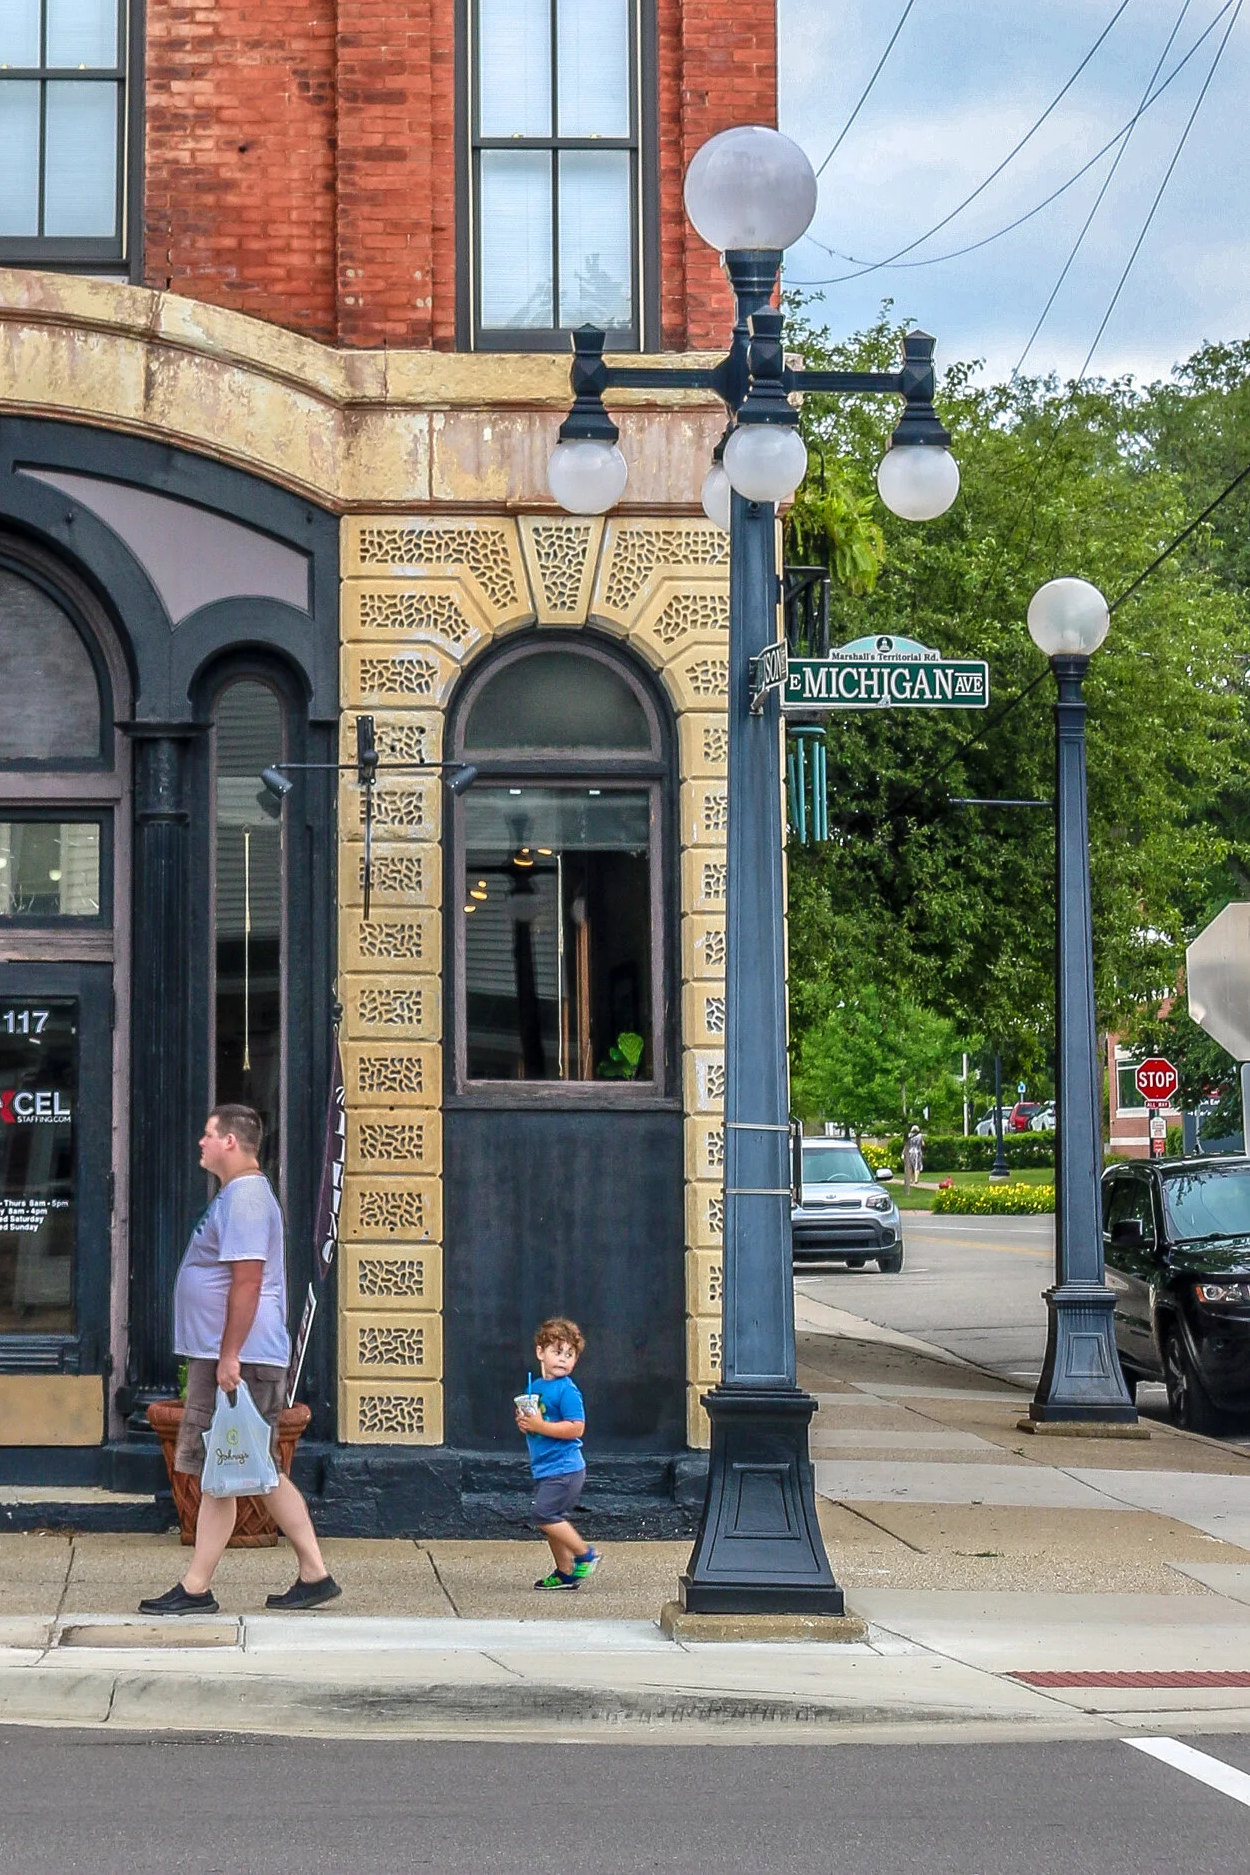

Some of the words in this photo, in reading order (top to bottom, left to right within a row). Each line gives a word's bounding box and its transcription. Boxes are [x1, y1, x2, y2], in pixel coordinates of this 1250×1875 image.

[831, 652, 875, 661] Marshall's
[877, 653, 921, 662] Territorial
[924, 653, 939, 662] Rd.
[789, 674, 802, 691] E
[802, 667, 955, 700] MICHIGAN
[954, 676, 983, 693] AVE
[3, 1010, 49, 1034] 117
[1138, 1071, 1175, 1088] STOP
[4, 1199, 26, 1207] Thurs
[9, 1215, 44, 1224] Saturday
[9, 1223, 39, 1232] Sunday
